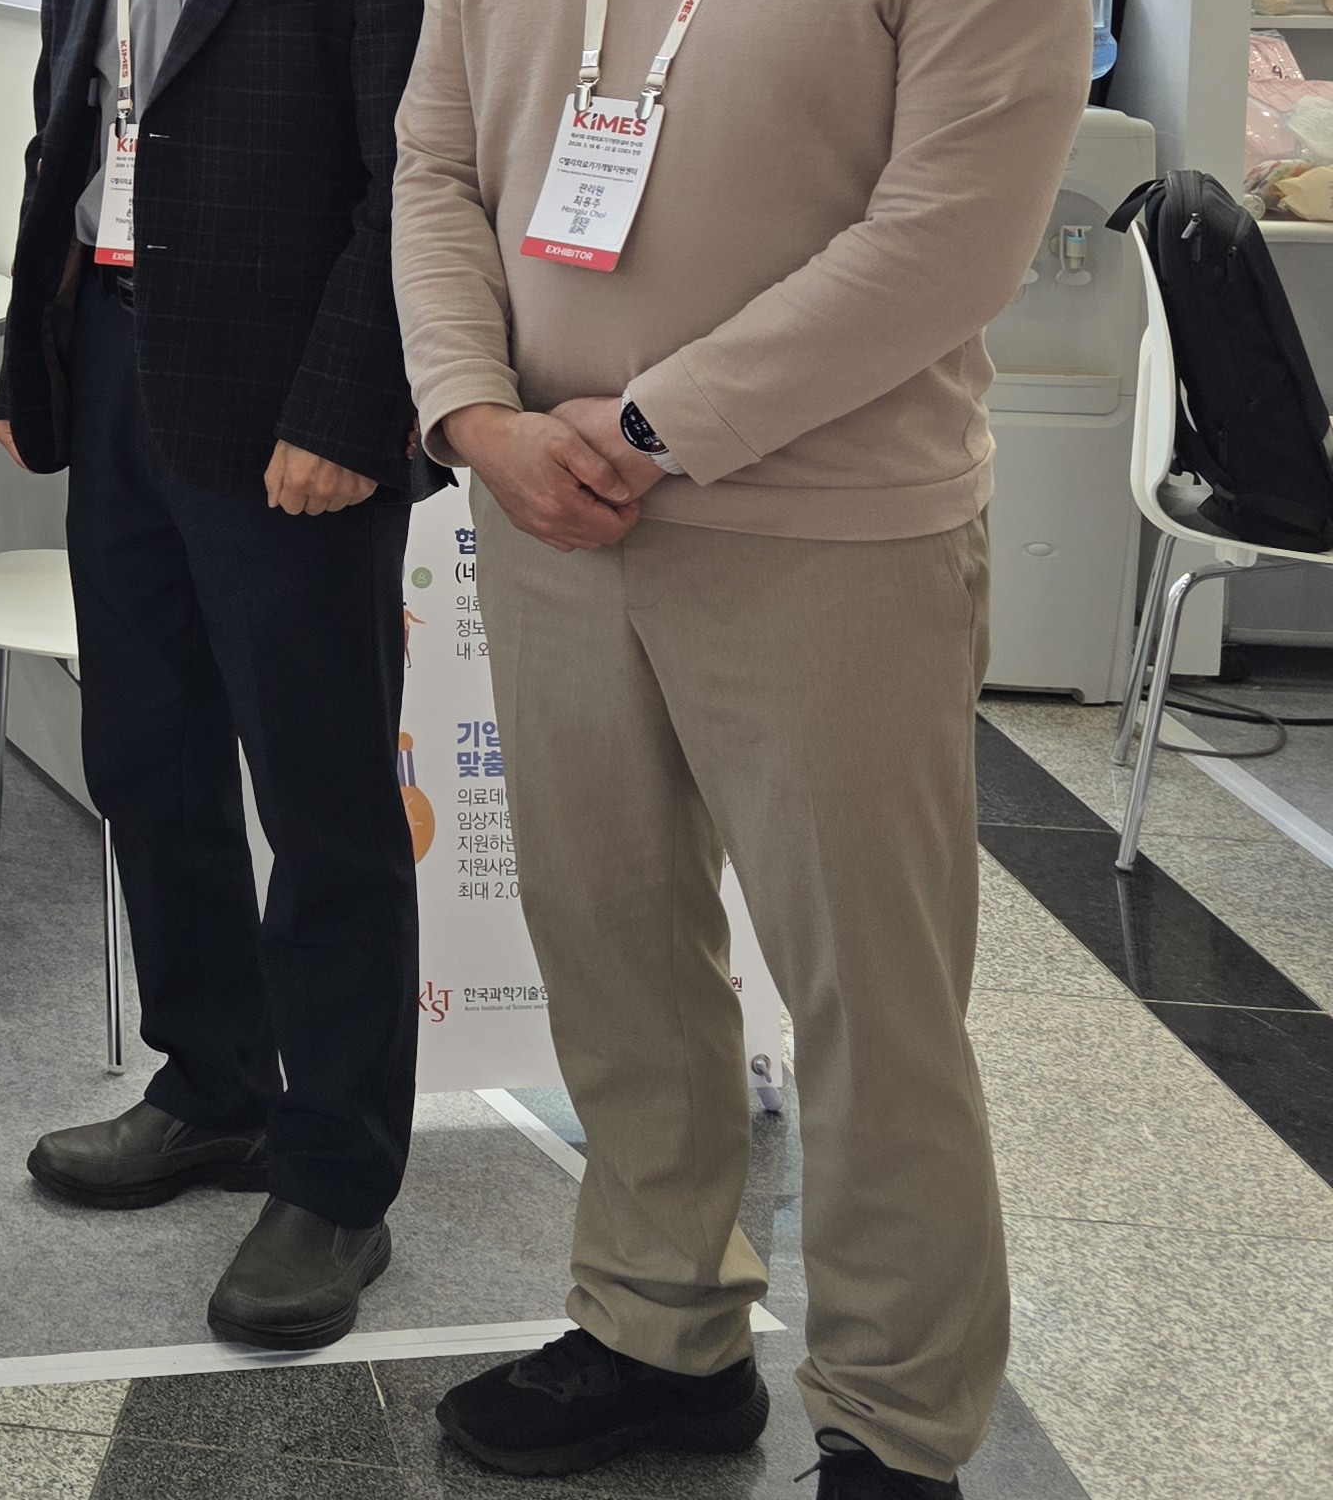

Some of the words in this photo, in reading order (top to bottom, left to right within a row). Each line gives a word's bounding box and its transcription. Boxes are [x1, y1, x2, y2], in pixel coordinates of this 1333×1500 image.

[572, 111, 649, 137] KiMES
[545, 244, 594, 261] EXHIBITOR
[457, 788, 506, 807] 의료데
[457, 857, 518, 877] 지원사업
[458, 881, 489, 900] 최대
